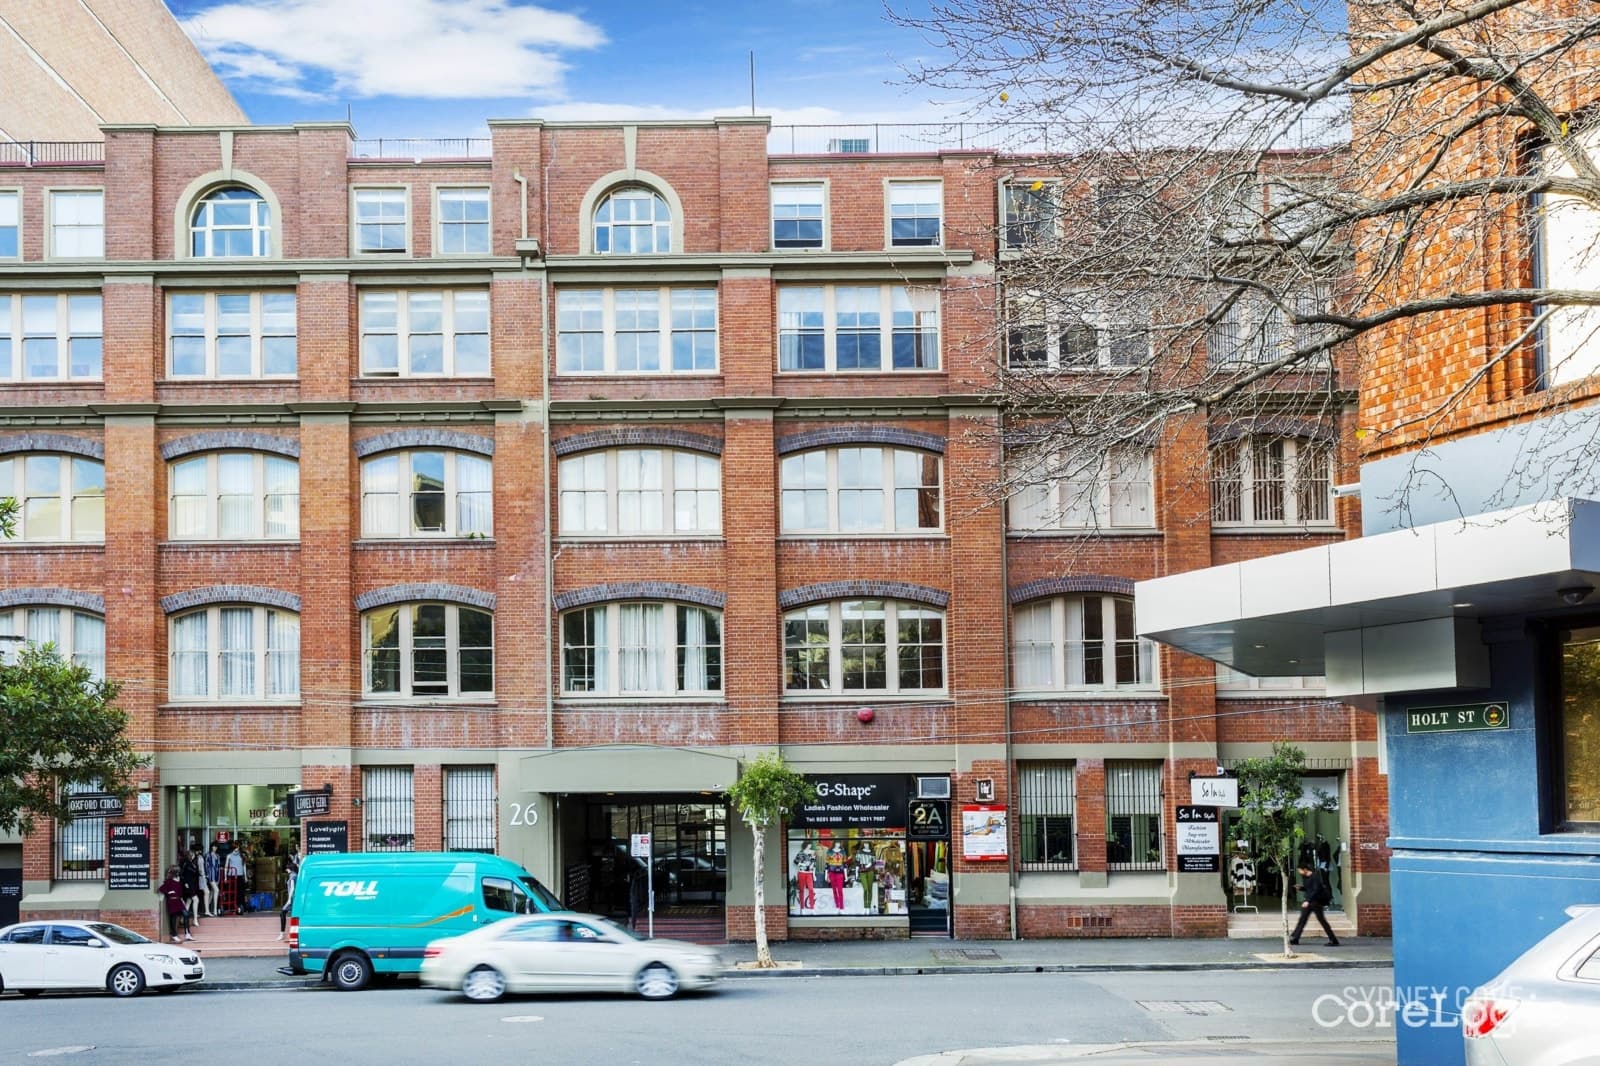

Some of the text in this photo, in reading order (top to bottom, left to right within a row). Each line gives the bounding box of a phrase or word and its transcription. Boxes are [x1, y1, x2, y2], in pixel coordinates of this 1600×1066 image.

[1412, 710, 1475, 726] HOLT ST
[70, 798, 122, 811] OXFORD CIRCUS
[296, 797, 316, 810] LOVELY
[249, 809, 267, 818] HOT
[509, 802, 538, 826] 26
[914, 807, 943, 825] 2A
[1179, 809, 1190, 820] So
[1192, 808, 1202, 819] In
[114, 826, 146, 836] HOT CHILLI
[310, 825, 346, 833] Lovelygirl
[319, 880, 379, 897] TOLL
